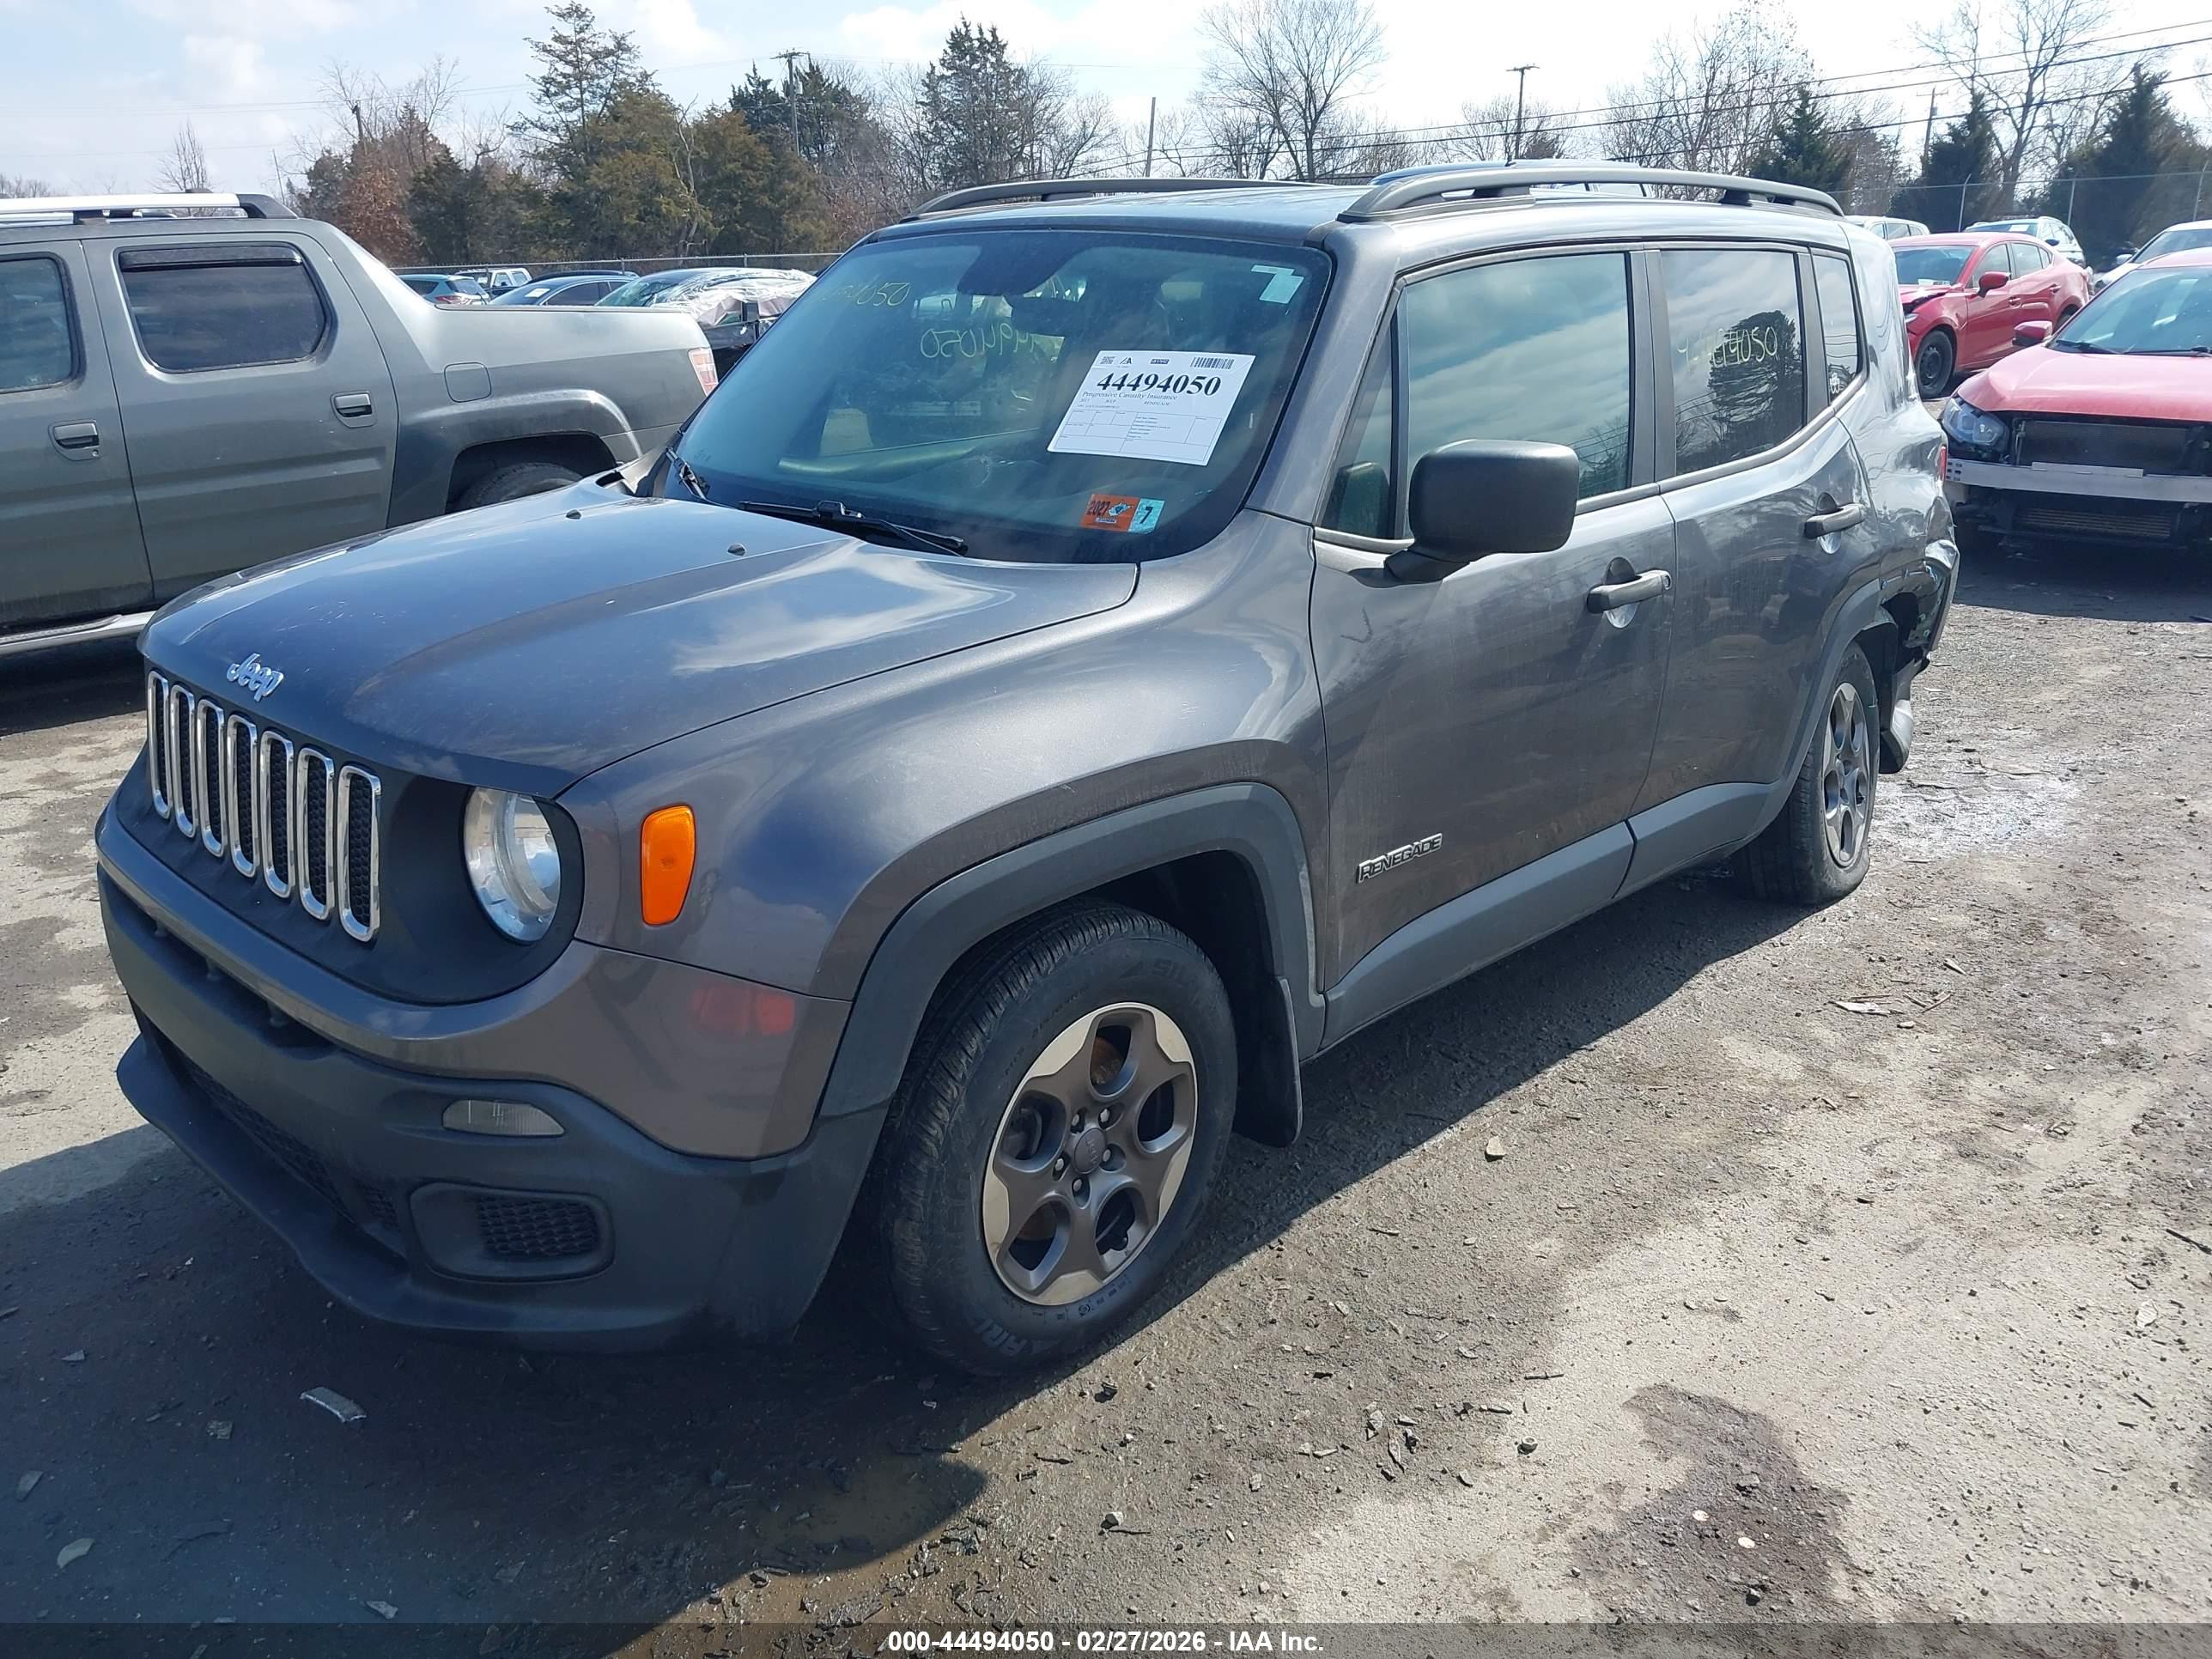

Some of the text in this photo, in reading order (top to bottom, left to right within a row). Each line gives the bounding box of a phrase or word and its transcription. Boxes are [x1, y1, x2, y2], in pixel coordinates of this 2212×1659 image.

[1082, 391, 1119, 399] Progressive
[1146, 392, 1178, 401] Insurance
[1097, 372, 1221, 396] 44494050
[1086, 500, 1153, 525] 2027 7
[226, 653, 284, 702] Jeep
[1356, 832, 1443, 884] RENEGADE
